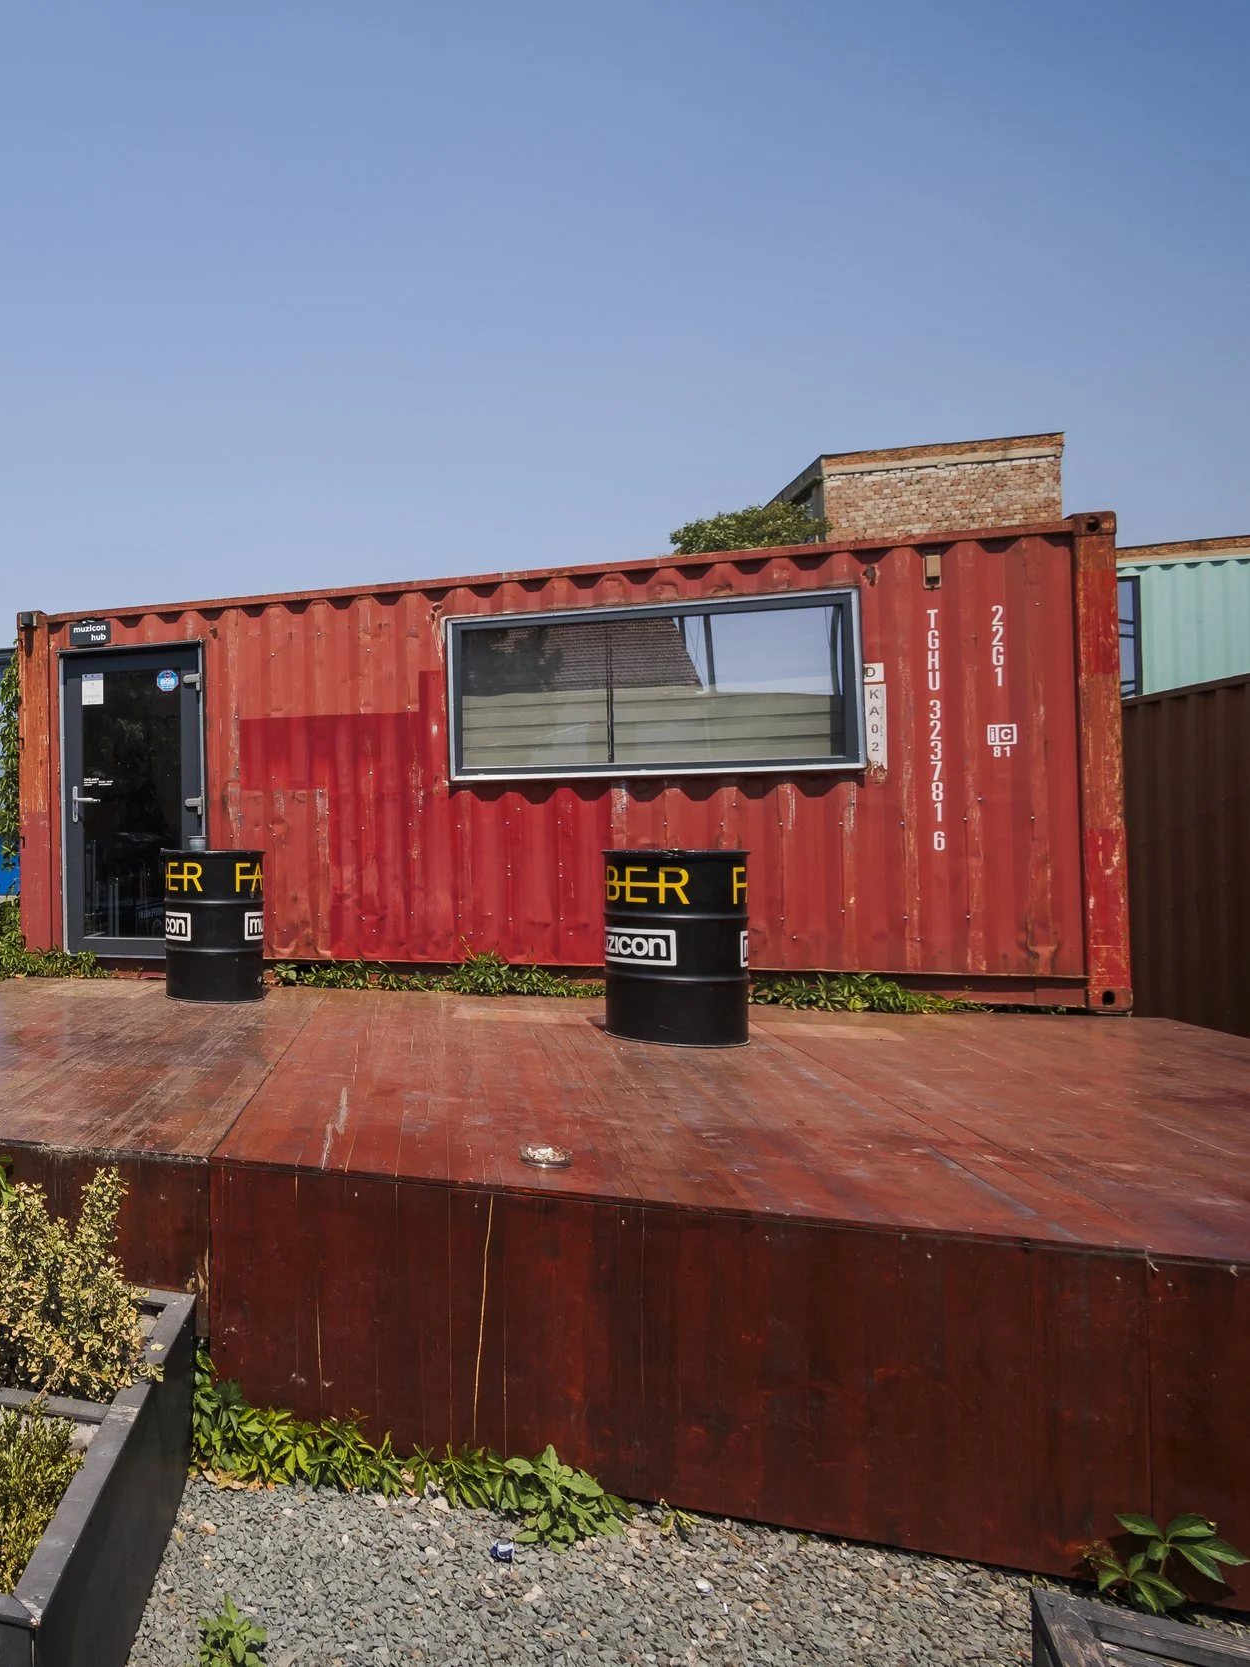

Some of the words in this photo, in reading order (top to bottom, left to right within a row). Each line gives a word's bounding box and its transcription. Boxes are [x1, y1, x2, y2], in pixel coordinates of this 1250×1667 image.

[73, 624, 107, 633] muzicon
[91, 633, 107, 641] hub
[927, 609, 940, 690] TGHU
[991, 605, 1004, 687] 22G1
[929, 700, 944, 822] 323781
[993, 745, 1011, 757] 81
